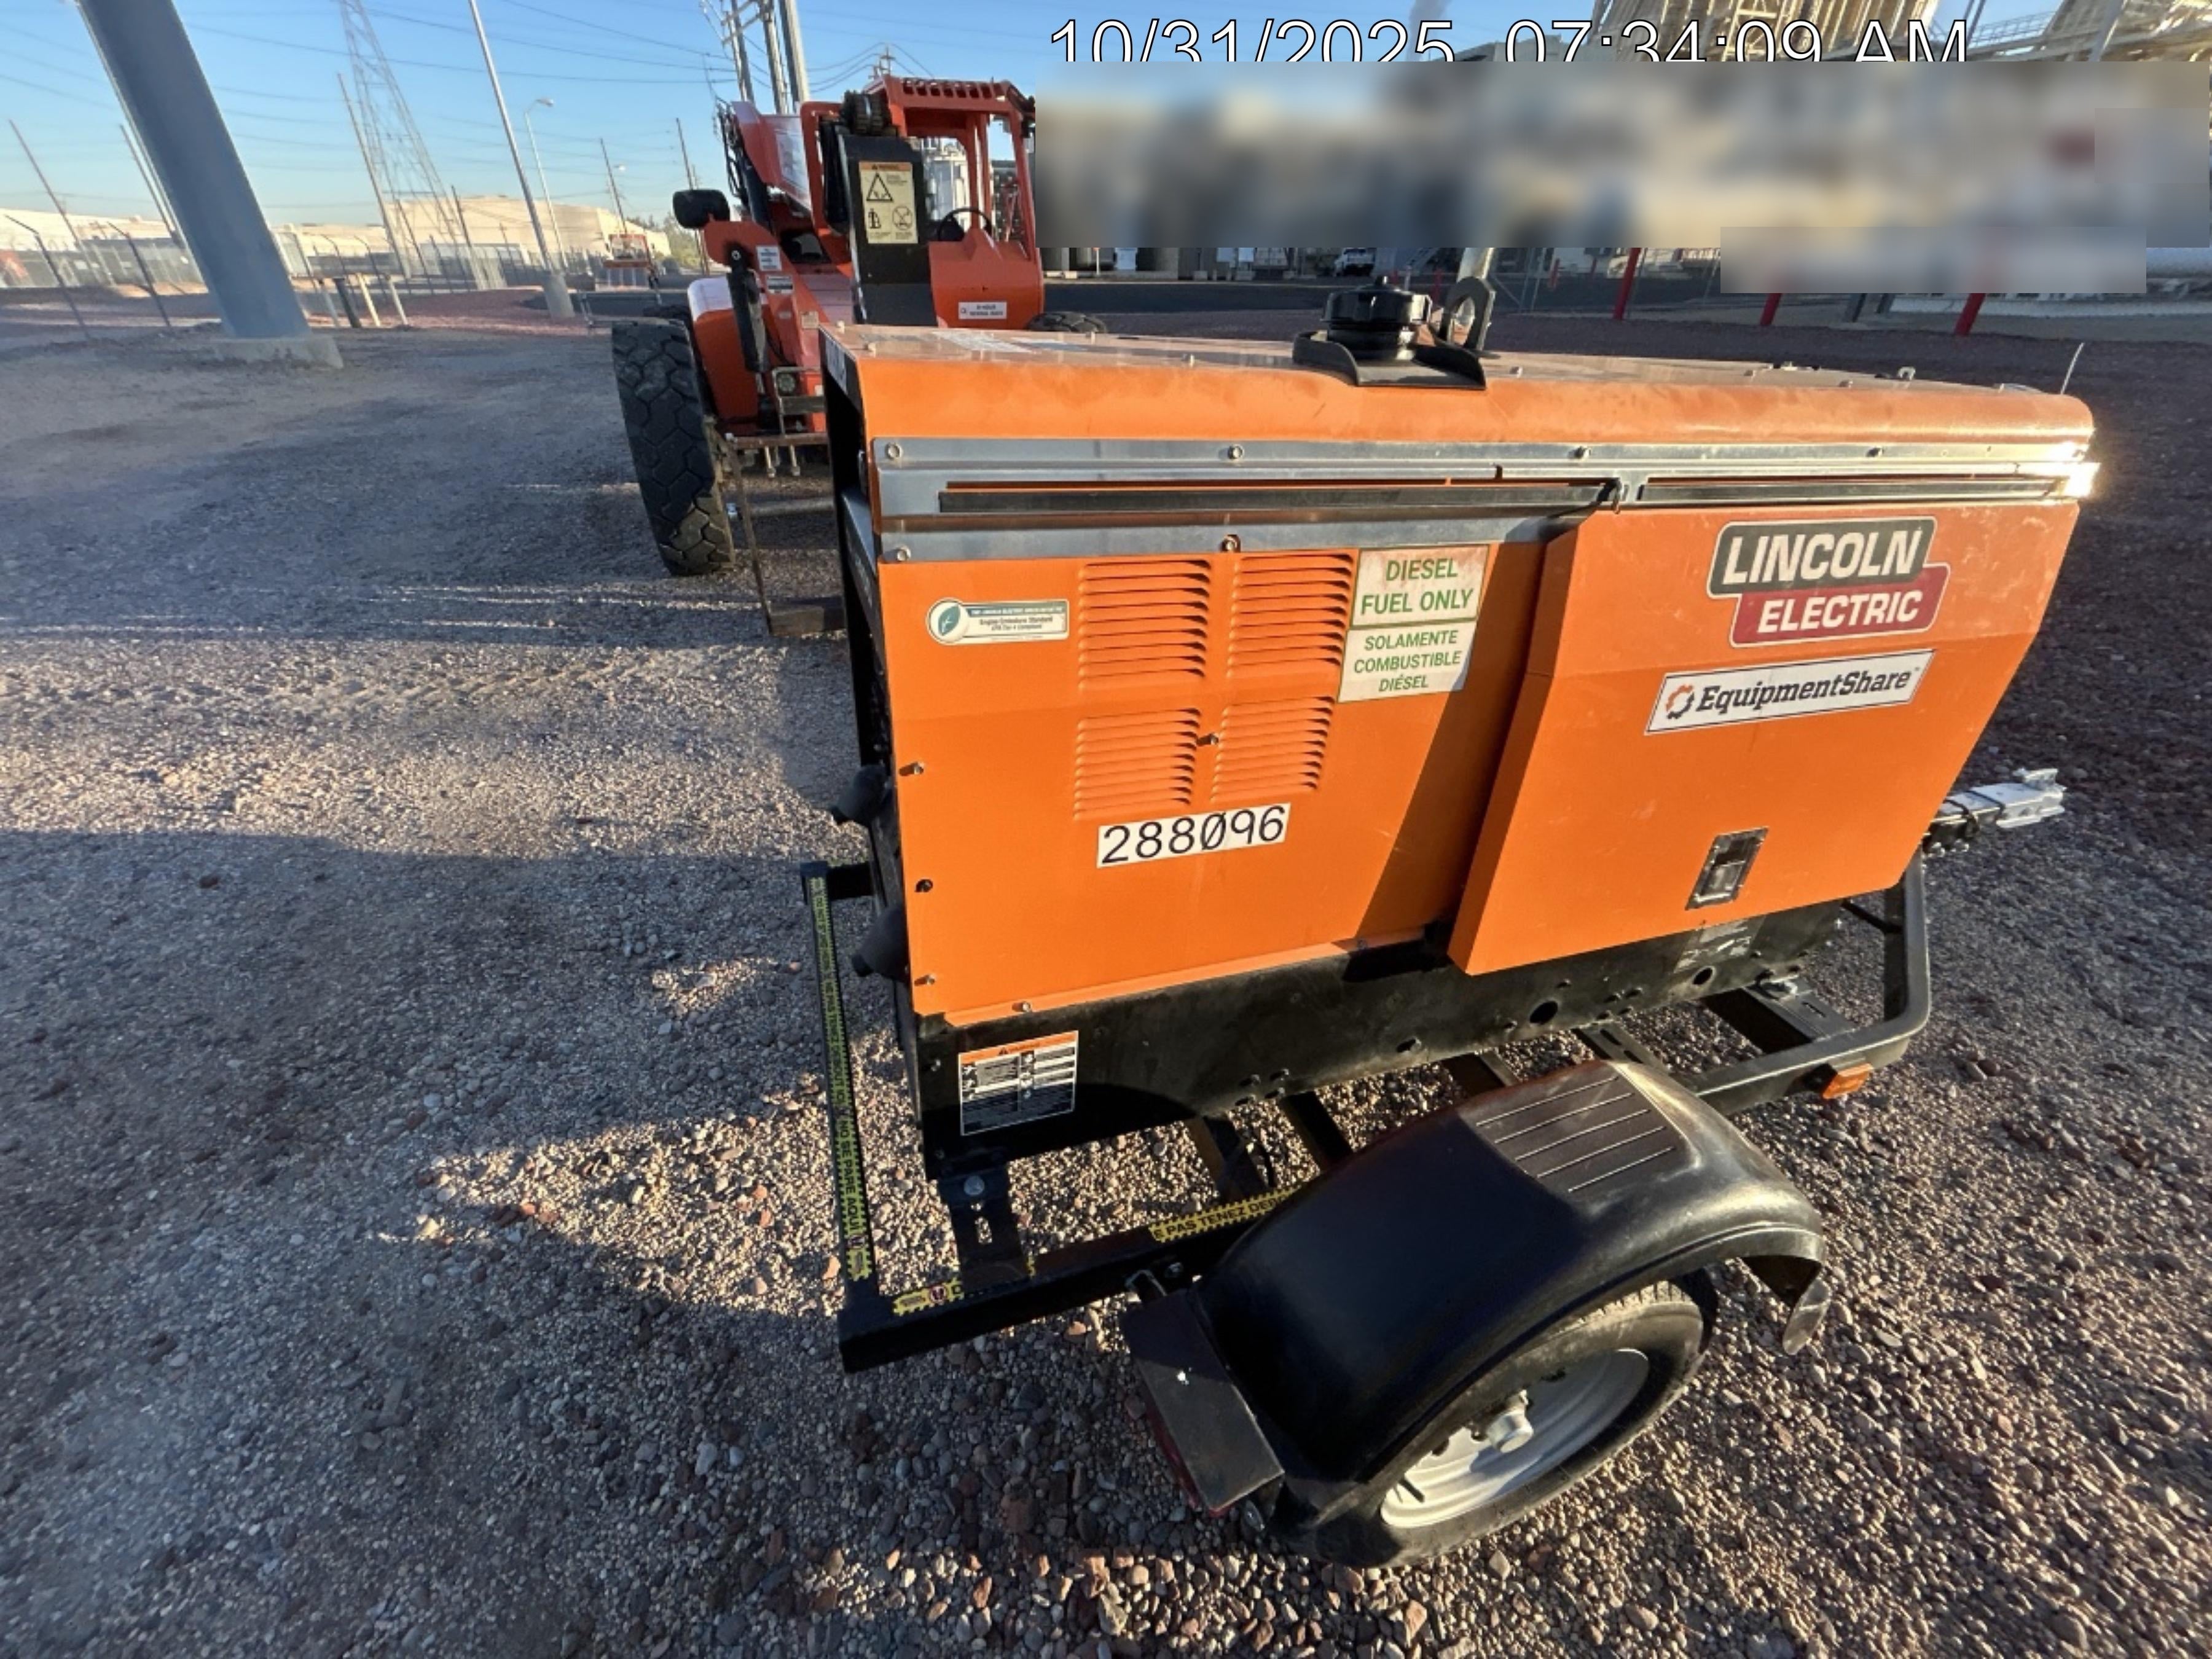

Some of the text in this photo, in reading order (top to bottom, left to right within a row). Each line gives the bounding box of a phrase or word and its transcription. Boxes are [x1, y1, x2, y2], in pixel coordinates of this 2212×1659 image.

[1386, 558, 1458, 581] DIESEL
[1722, 527, 1922, 585] LINCOLN
[1360, 588, 1475, 614] FUEL ONLY
[1757, 589, 1923, 633] ELECTRIC
[1364, 629, 1459, 651] SOLAMENTE
[1354, 650, 1462, 674] COMBUSTIBLE
[1378, 673, 1429, 692] DIÉSEL
[1695, 669, 1912, 715] EquipmentShare
[1102, 805, 1285, 865] 288096
[843, 1160, 856, 1195] PARE
[1166, 1219, 1197, 1236] PAS
[1198, 1207, 1248, 1227] TENEZ
